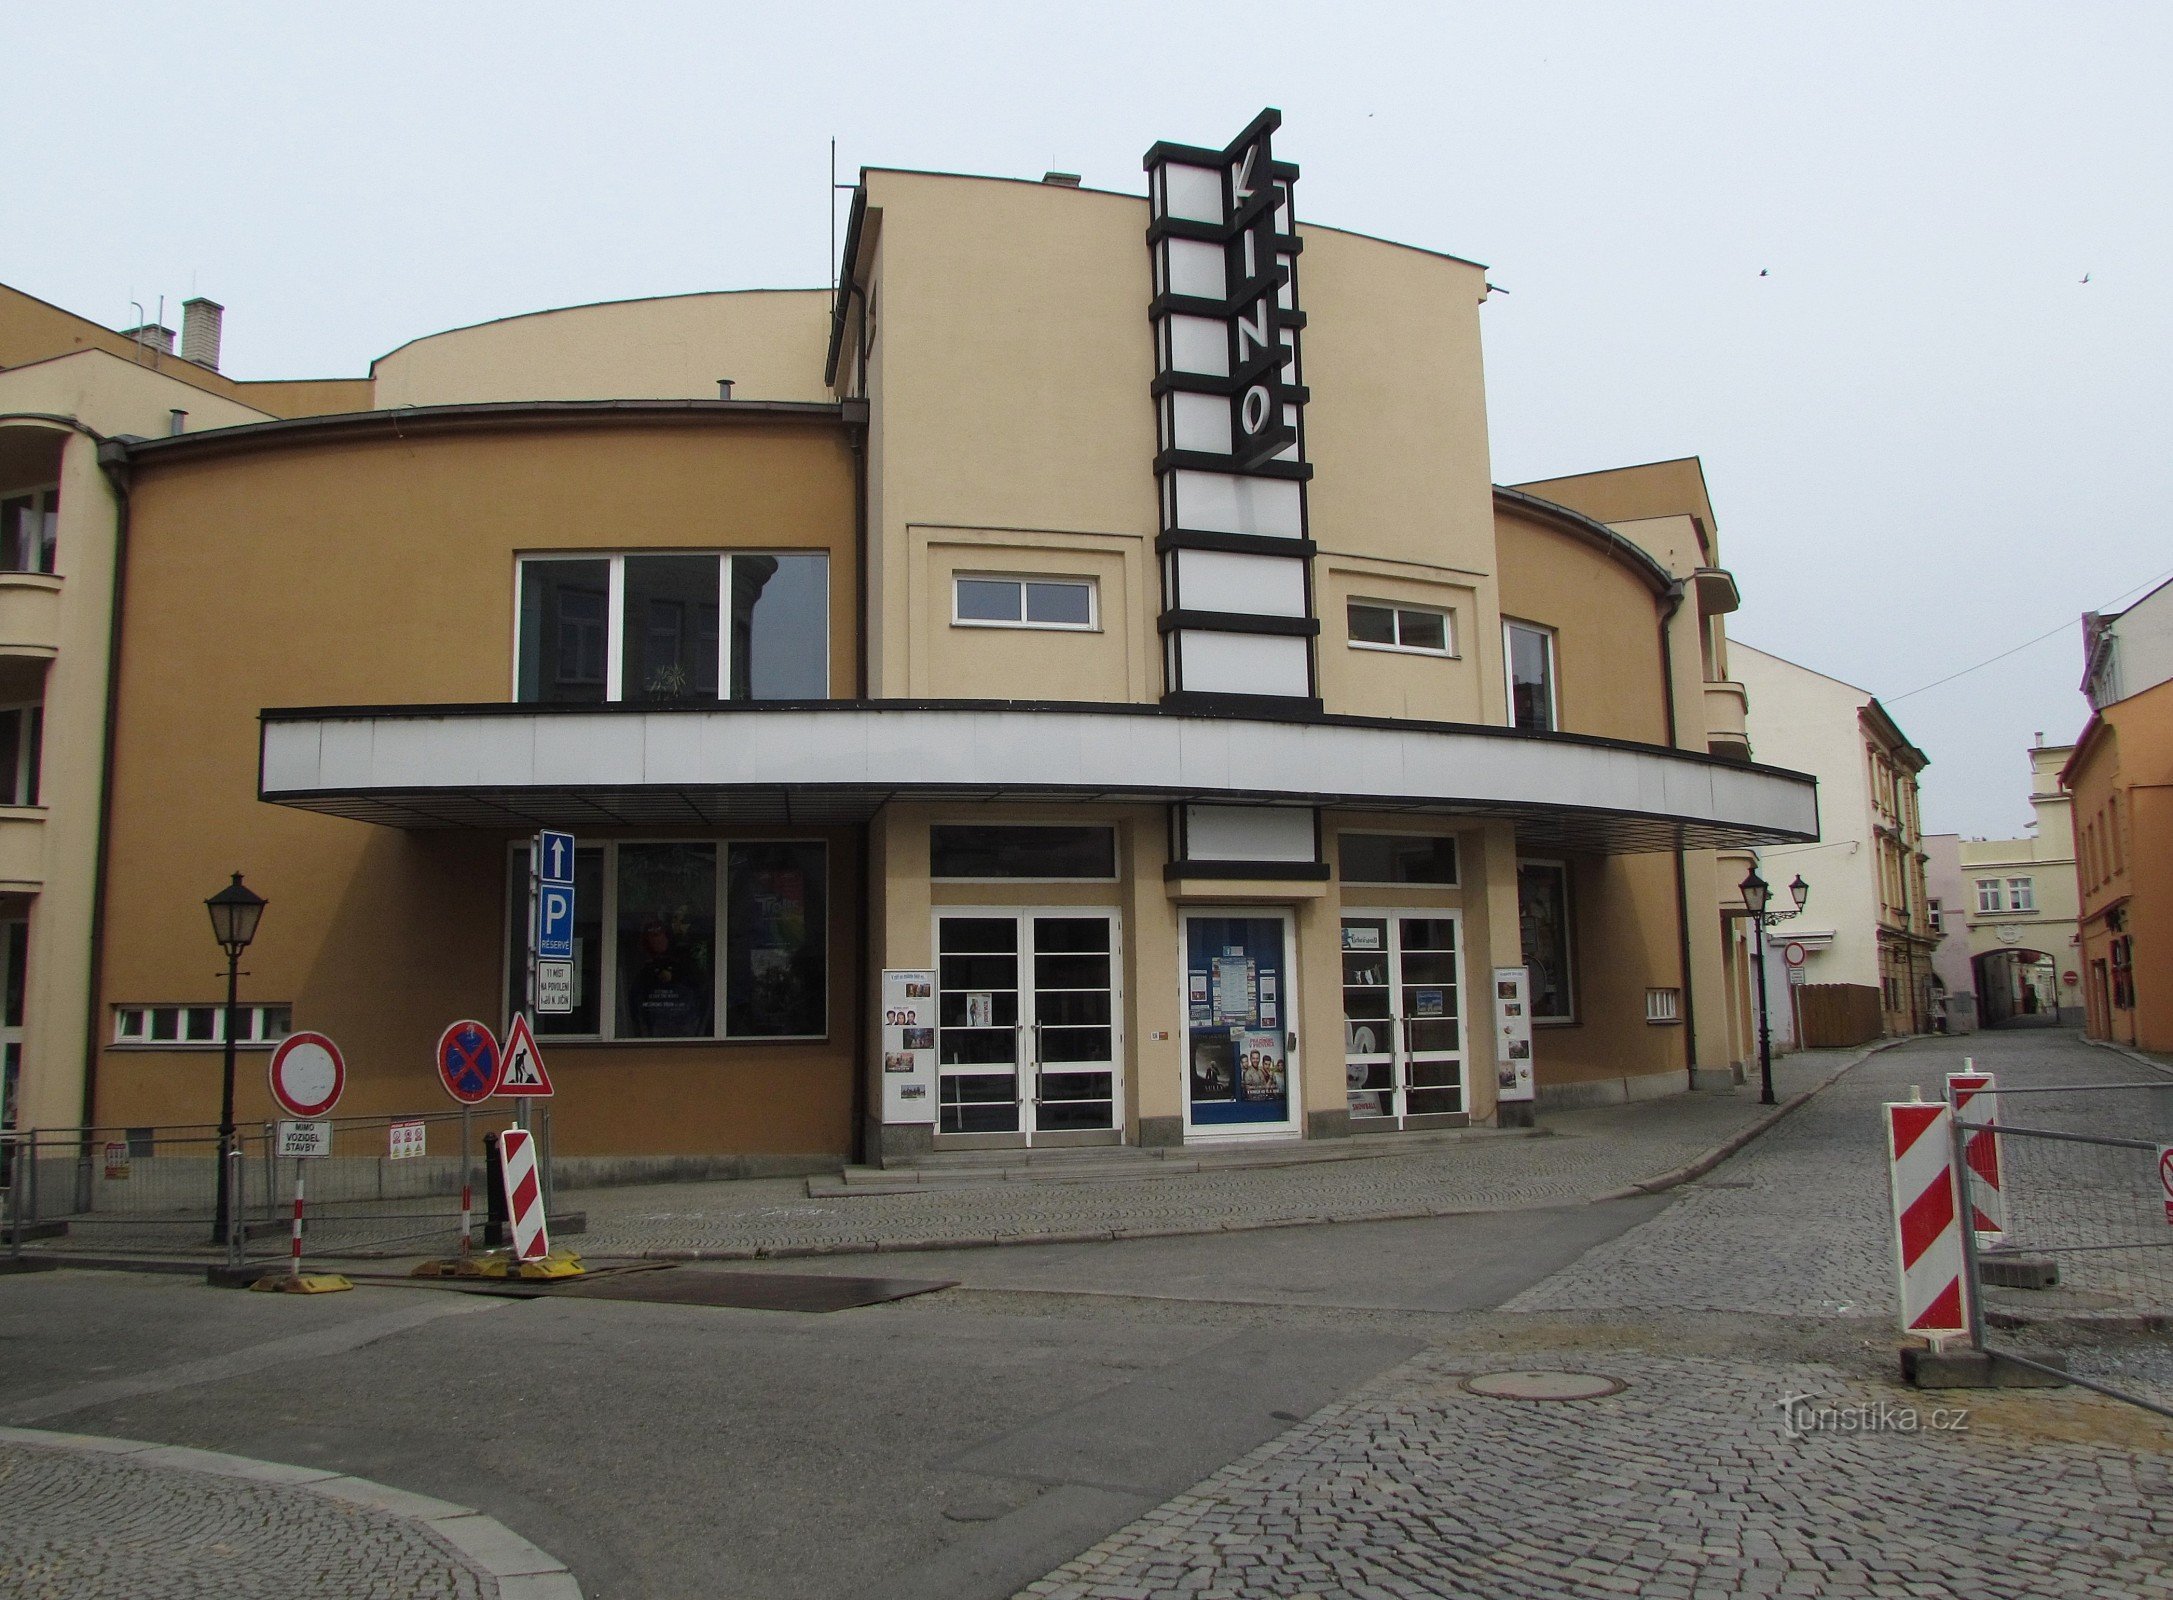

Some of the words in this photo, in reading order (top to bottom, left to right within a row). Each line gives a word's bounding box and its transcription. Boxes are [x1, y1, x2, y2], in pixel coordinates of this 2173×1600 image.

[1231, 144, 1271, 435] KINO
[546, 894, 567, 935] P
[541, 939, 570, 950] RÉSERVÉ
[295, 1123, 315, 1131] MIMO
[286, 1133, 320, 1142] VOZIDEL
[285, 1143, 316, 1152] STAVBY
